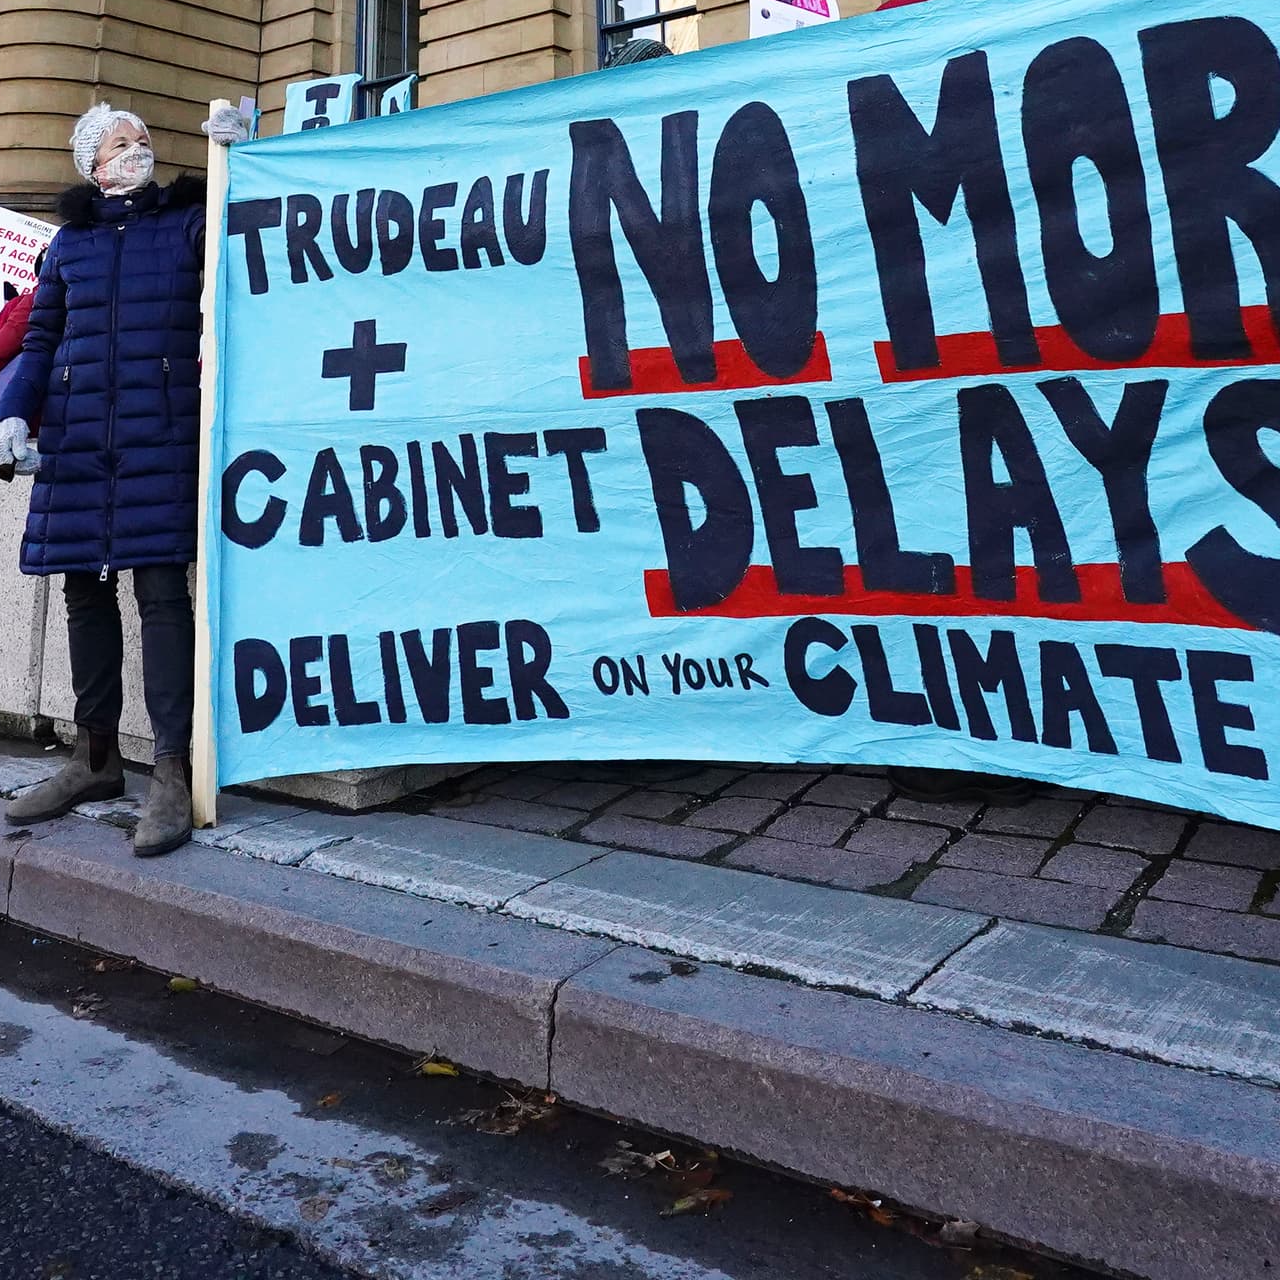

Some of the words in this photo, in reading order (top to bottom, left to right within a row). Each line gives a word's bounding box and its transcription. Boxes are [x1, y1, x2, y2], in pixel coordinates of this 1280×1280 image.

[9, 249, 36, 264] ACR
[227, 169, 550, 295] TRUDEAU
[569, 101, 818, 391] NO
[221, 427, 607, 550] CABINET
[233, 620, 571, 734] DELIVER
[592, 653, 651, 696] ON
[661, 652, 770, 696] YOUR
[784, 616, 1269, 781] CLIMATE
